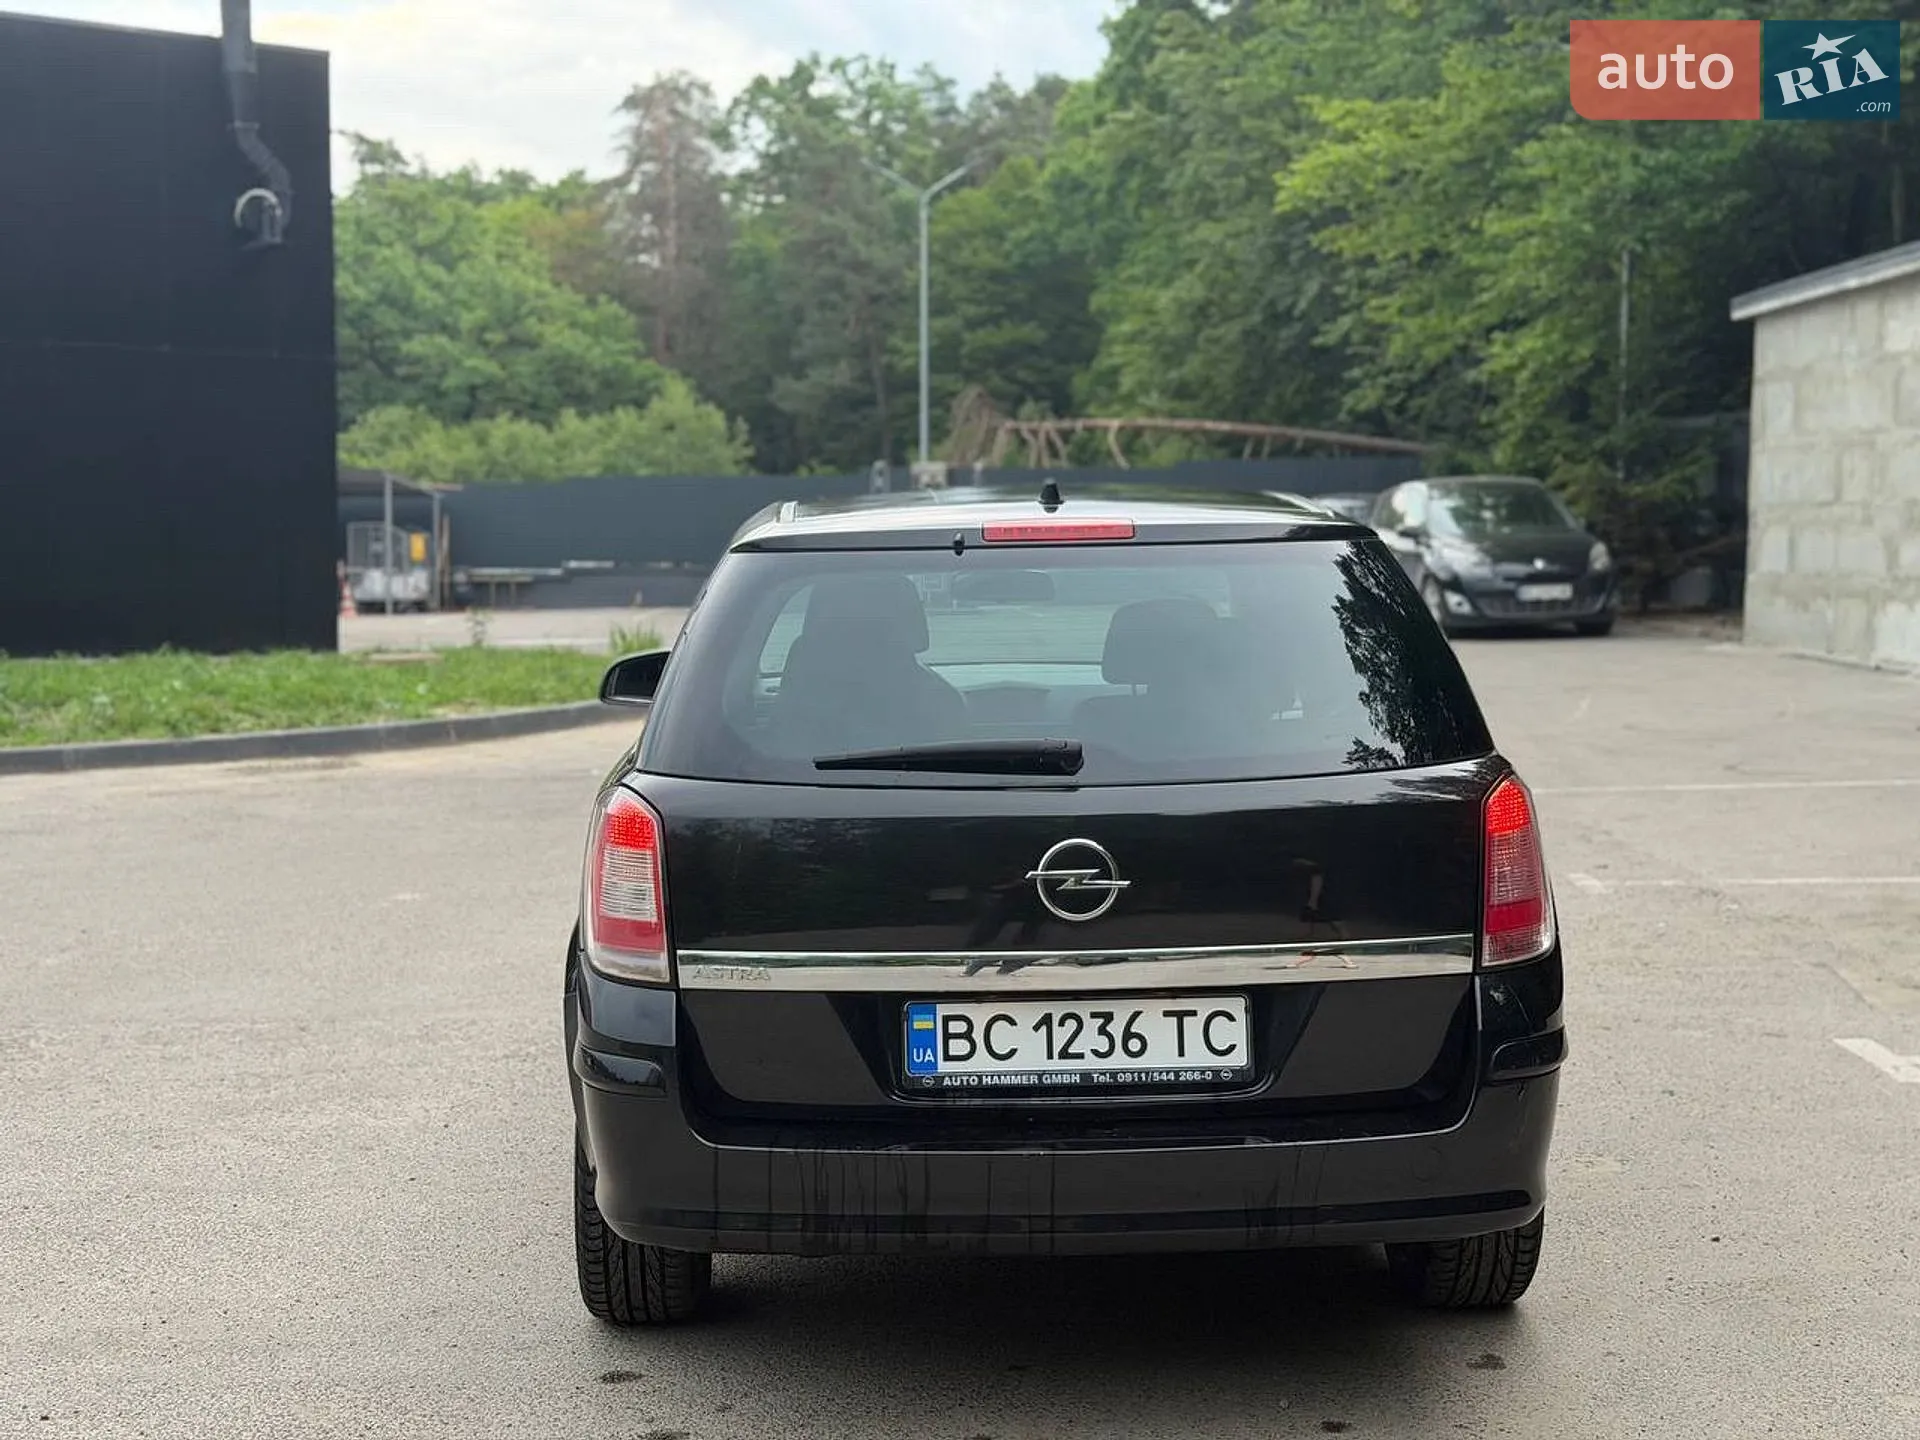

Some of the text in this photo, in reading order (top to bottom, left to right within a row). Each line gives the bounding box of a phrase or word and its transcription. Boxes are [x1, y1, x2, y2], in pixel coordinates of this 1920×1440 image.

[692, 964, 771, 982] ASTRA
[942, 1010, 1237, 1062] BC 1236 TC
[913, 1049, 935, 1063] UA
[943, 1075, 978, 1086] AUTO
[982, 1074, 1039, 1086] HAMMER
[1042, 1073, 1080, 1085] GMBH
[1092, 1072, 1113, 1083] Tel.
